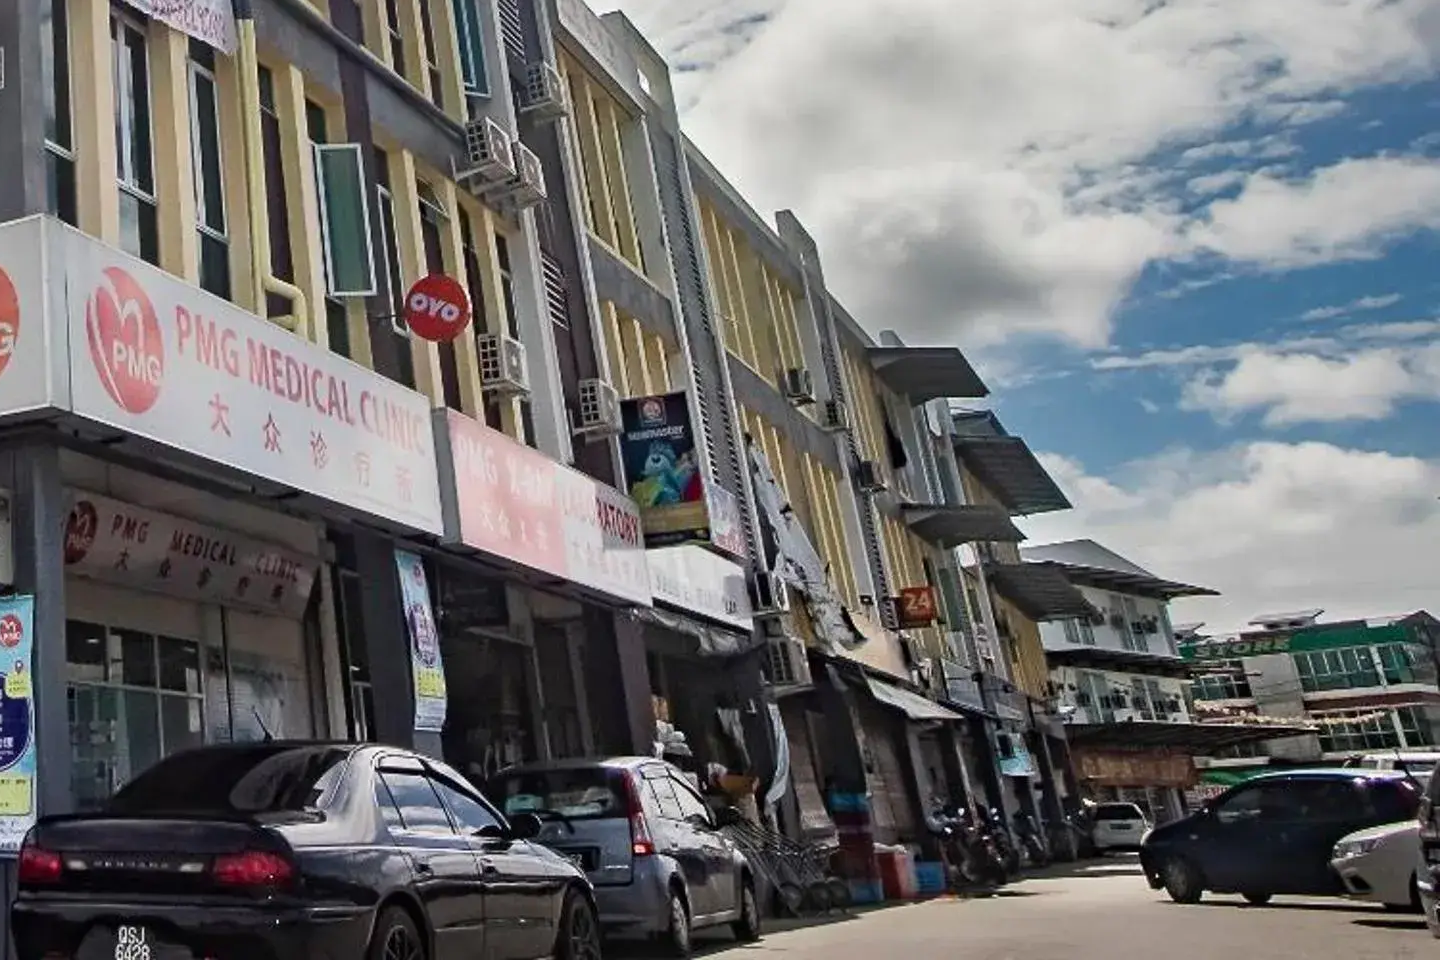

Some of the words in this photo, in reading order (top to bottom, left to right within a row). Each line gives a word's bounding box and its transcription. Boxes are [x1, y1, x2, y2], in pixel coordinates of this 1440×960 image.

[411, 292, 460, 322] OYO
[113, 341, 162, 385] PMG
[175, 304, 240, 377] PMG
[246, 337, 356, 426] MEDICAL
[359, 390, 426, 456] CLINIC
[111, 514, 150, 544] PMG
[169, 529, 237, 567] MEDICAL
